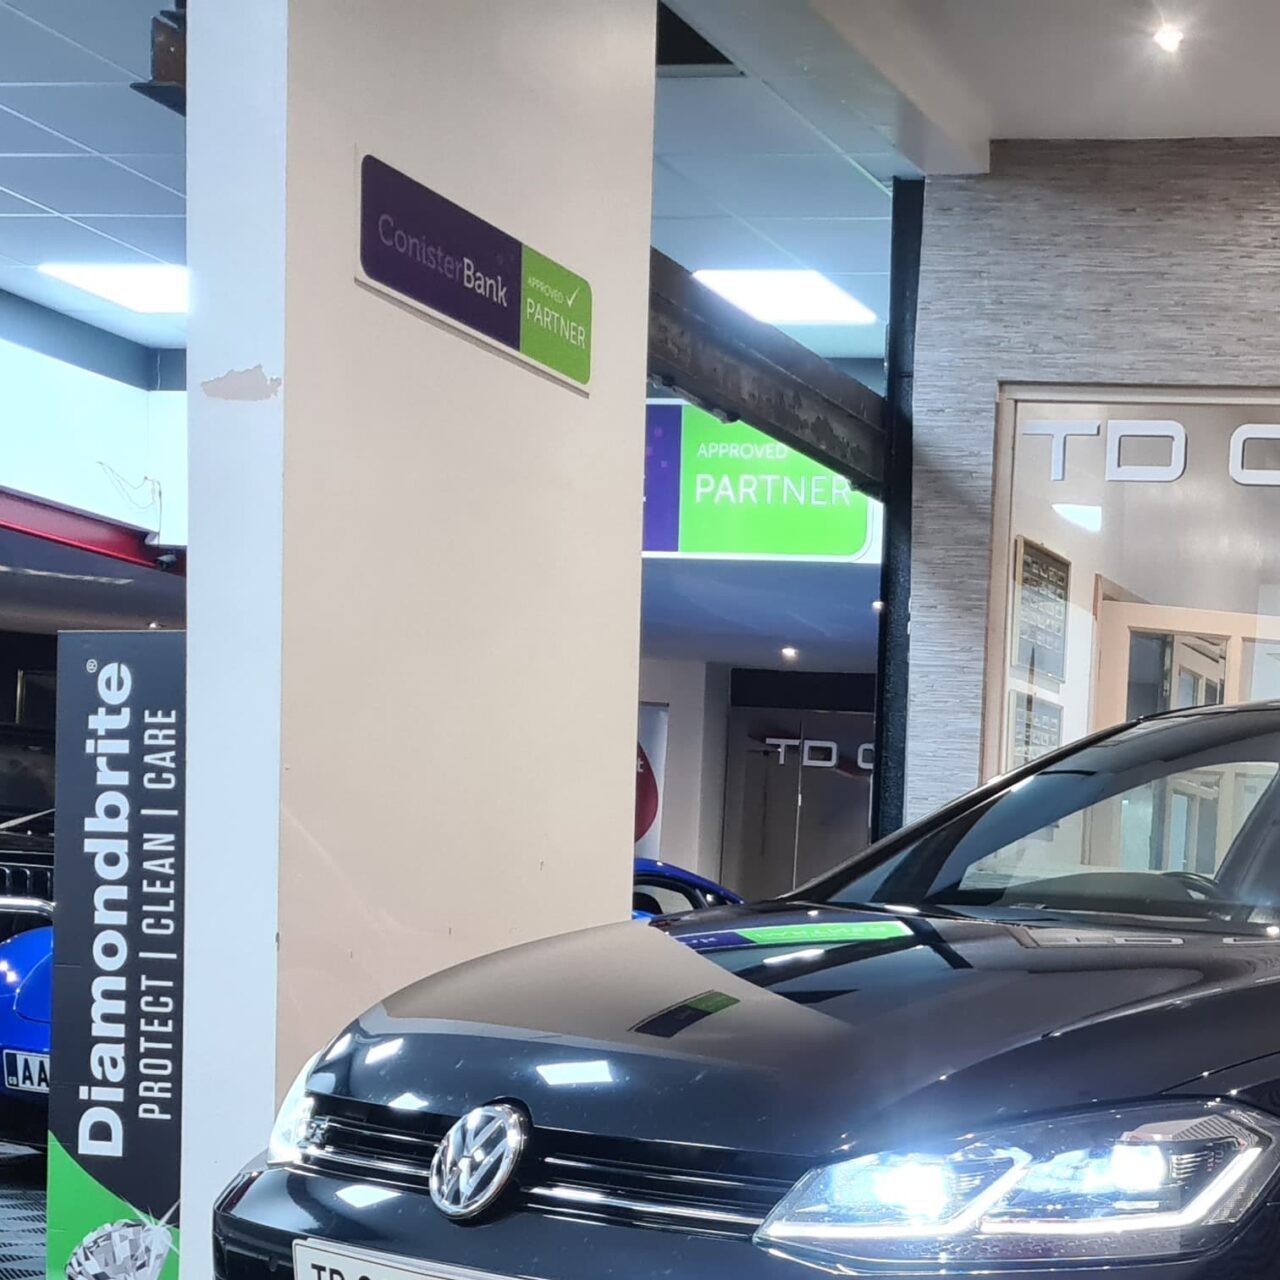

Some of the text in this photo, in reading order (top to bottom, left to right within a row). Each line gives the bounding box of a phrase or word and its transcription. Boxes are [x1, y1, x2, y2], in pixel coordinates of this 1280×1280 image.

[378, 213, 508, 307] ConisterBank
[527, 276, 563, 304] APPROVED
[526, 299, 586, 349] PARTNER
[697, 442, 789, 460] APPROVED
[1022, 420, 1186, 482] TD
[695, 474, 851, 506] PARTNER
[766, 737, 838, 768] TD
[138, 709, 177, 1120] PROTECT CLEAN CARE
